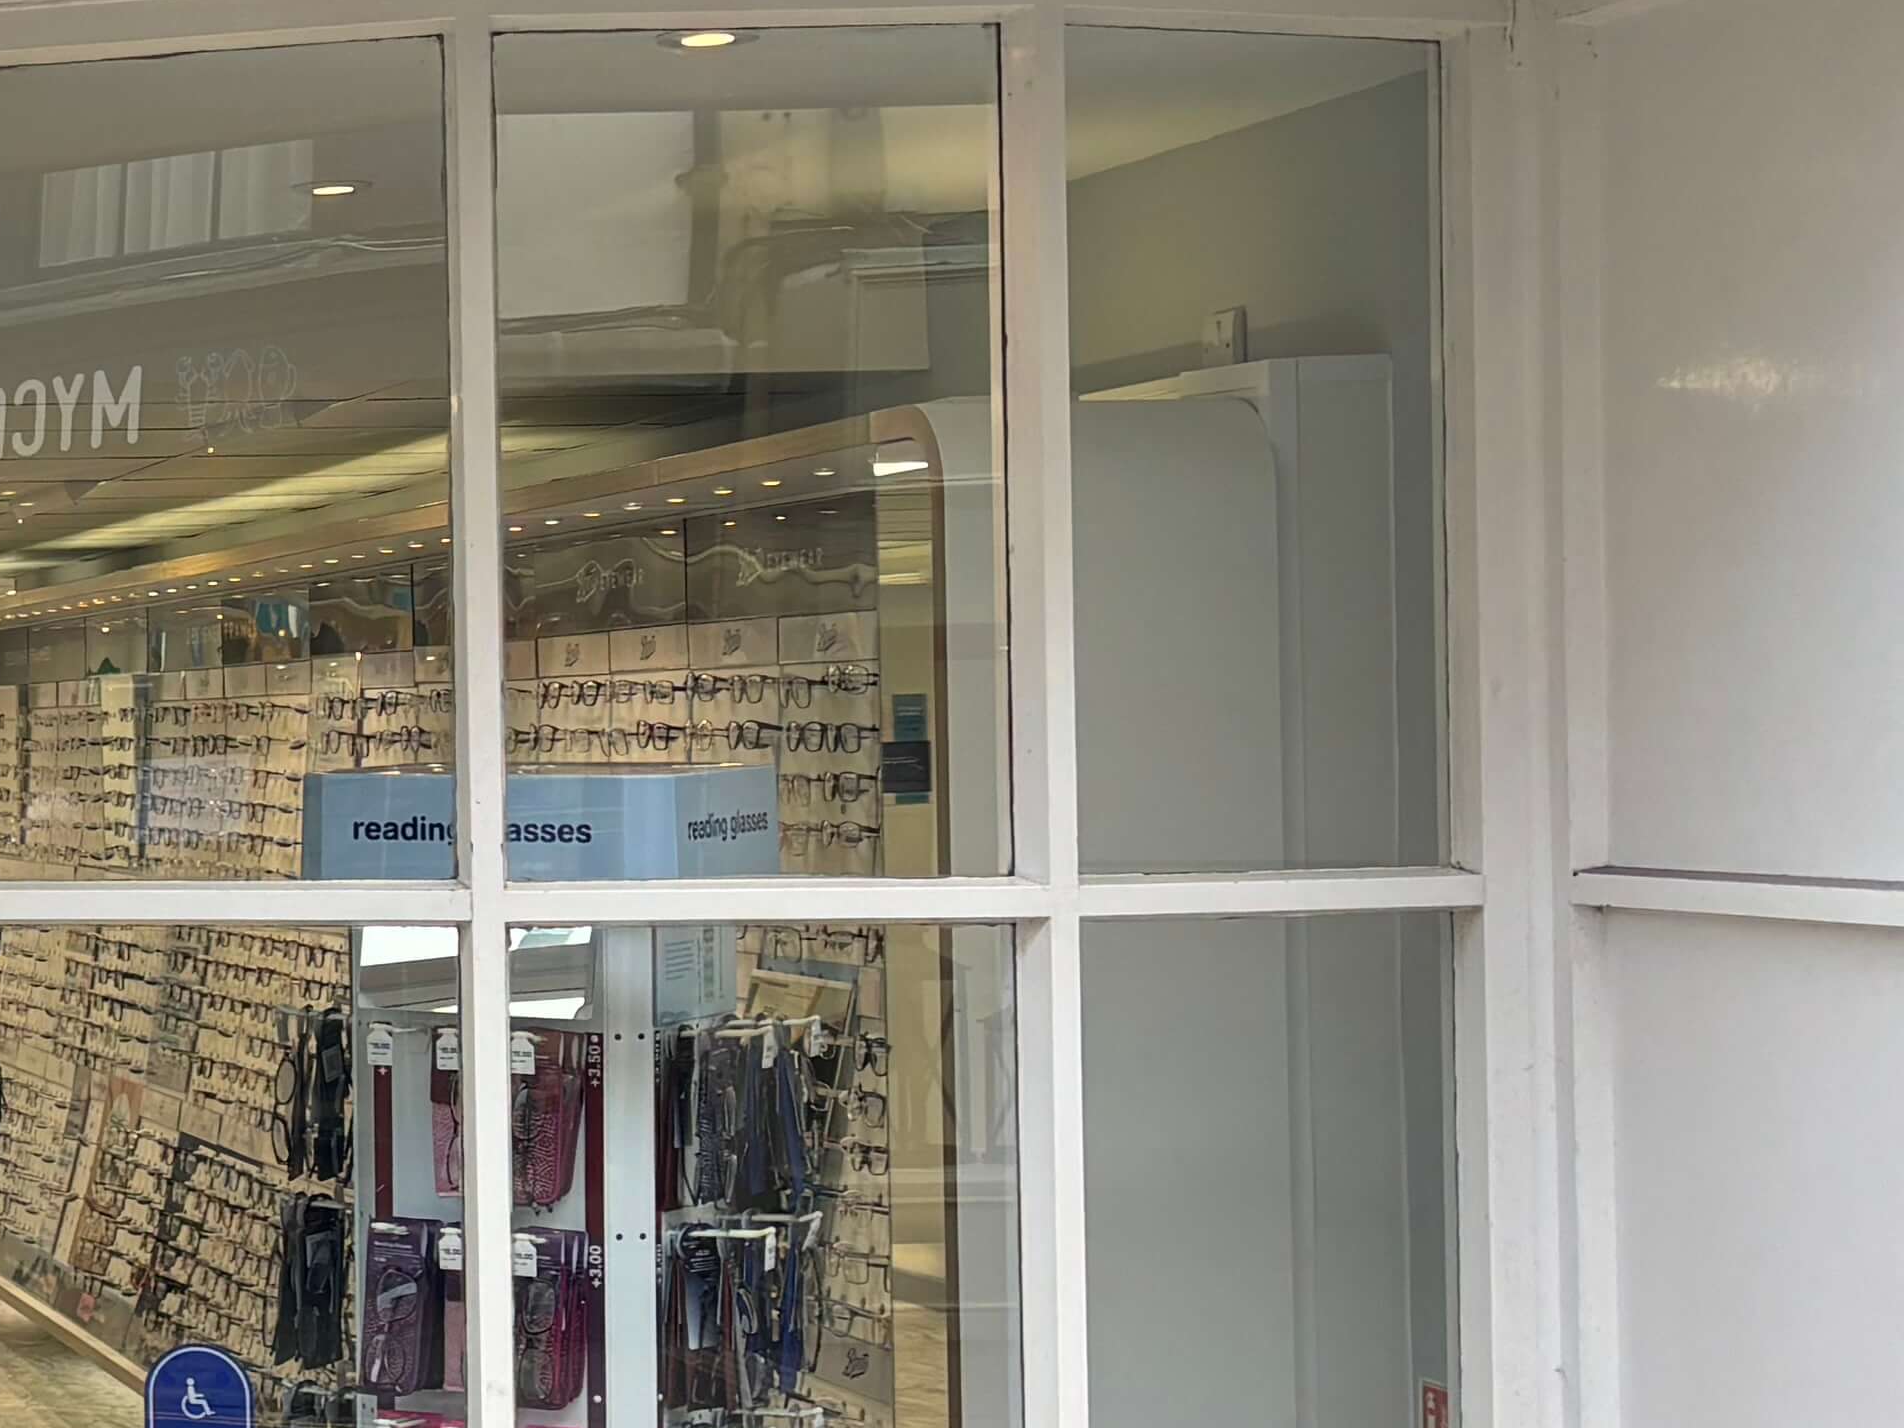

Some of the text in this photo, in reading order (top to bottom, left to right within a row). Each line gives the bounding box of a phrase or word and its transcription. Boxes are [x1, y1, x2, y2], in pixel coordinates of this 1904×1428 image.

[506, 822, 592, 843] asses
[688, 810, 769, 841] reading glasses
[588, 1044, 602, 1088] +3.50
[589, 1245, 603, 1288] +3.00
